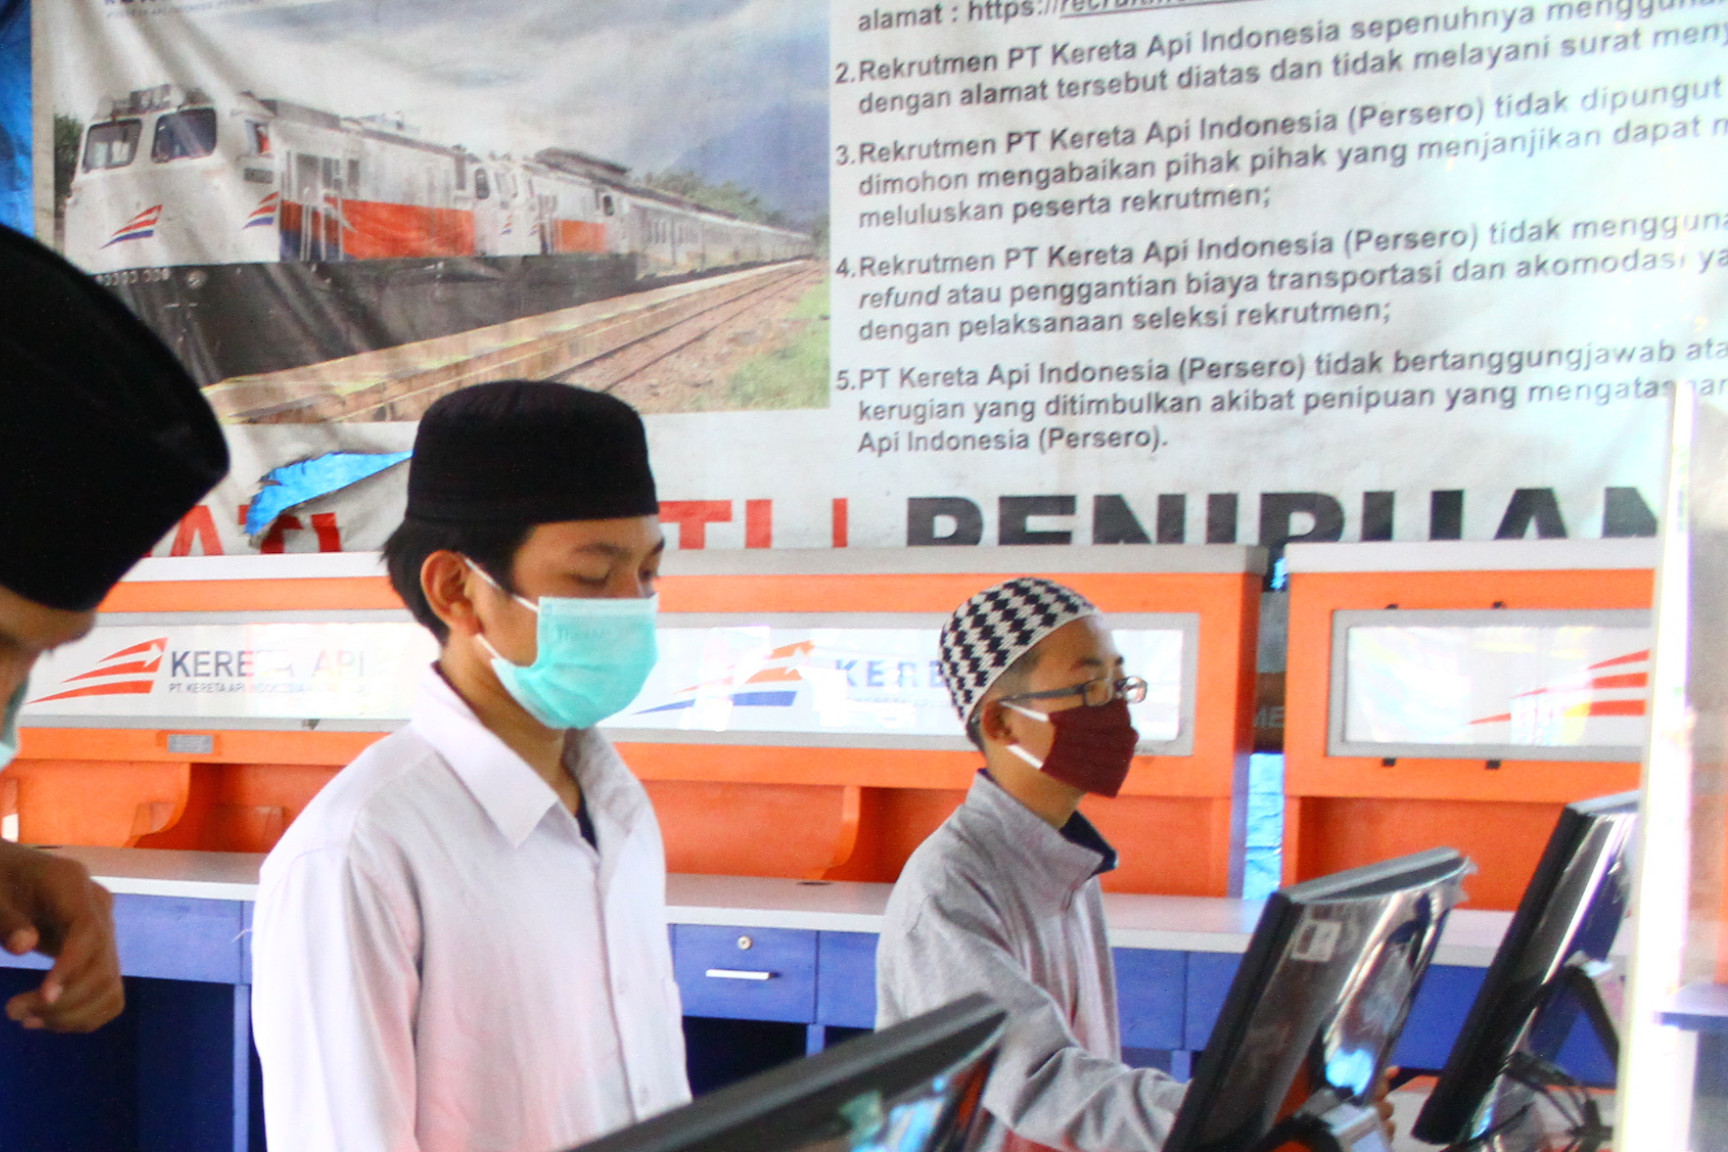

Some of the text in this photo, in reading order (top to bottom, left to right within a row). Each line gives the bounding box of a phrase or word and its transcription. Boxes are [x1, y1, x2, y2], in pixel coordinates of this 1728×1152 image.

[858, 3, 943, 32] alamat
[859, 54, 998, 81] Rekrutmen
[1008, 45, 1042, 69] PT
[1051, 39, 1137, 66] Kereta
[1146, 32, 1191, 62] Api
[1200, 19, 1340, 52] Indonesia
[1351, 6, 1535, 42] sepenuhnya
[859, 90, 951, 116] dengan
[960, 79, 1048, 105] alamat
[1056, 69, 1168, 99] tersebut
[1176, 64, 1260, 90] diatas
[1270, 57, 1322, 82] dan
[1332, 48, 1402, 76] tidak
[1414, 35, 1549, 70] melayani
[1560, 28, 1641, 57] surat
[859, 138, 996, 164] Rekrutmen
[1006, 130, 1041, 154] PT
[1050, 125, 1136, 151] Kereta
[1145, 119, 1190, 148] Api
[1198, 109, 1337, 140] Indonesia
[1348, 97, 1484, 135] (Persero)
[1495, 90, 1568, 118] tidak
[1581, 75, 1722, 115] dipungut
[859, 170, 968, 196] dimohon
[978, 158, 1155, 191] mengabaikan
[1165, 149, 1240, 182] pihak
[1250, 144, 1326, 177] pihak
[1337, 144, 1407, 172] yang
[1418, 128, 1600, 161] menjanjikan
[1613, 115, 1701, 146] dapat
[859, 187, 1270, 228] meluluskan peserta rekrutmen;
[859, 254, 995, 277] Rekrutmen
[1005, 246, 1039, 269] PT
[1048, 244, 1134, 268] Kereta
[1143, 239, 1188, 268] Api
[1197, 232, 1334, 260] Indonesia
[1344, 226, 1478, 258] (Persero)
[1489, 218, 1560, 245] tidak
[859, 284, 941, 309] refund
[947, 284, 1001, 305] atau
[1010, 274, 1177, 307] penggantian
[1186, 272, 1259, 299] biaya
[1267, 260, 1442, 293] transportasi
[1452, 259, 1506, 282] dan
[1516, 248, 1685, 278] akomodasi
[859, 301, 1390, 344] dengan pelaksanaan seleksi rekrutmen;
[859, 368, 891, 390] PT
[900, 366, 979, 388] Kereta
[987, 363, 1029, 390] Api
[1040, 359, 1170, 384] Indonesia
[1178, 354, 1305, 385] (Persero)
[1315, 350, 1383, 376] tidak
[1393, 340, 1676, 376] bertanggungjawab
[859, 398, 965, 425] kerugian
[974, 400, 1035, 423] yang
[1045, 392, 1201, 416] ditimbulkan
[1211, 389, 1295, 412] akibat
[1303, 386, 1435, 416] penipuan
[1445, 386, 1517, 412] yang
[857, 426, 1168, 458] Api Indonesia (Persero).
